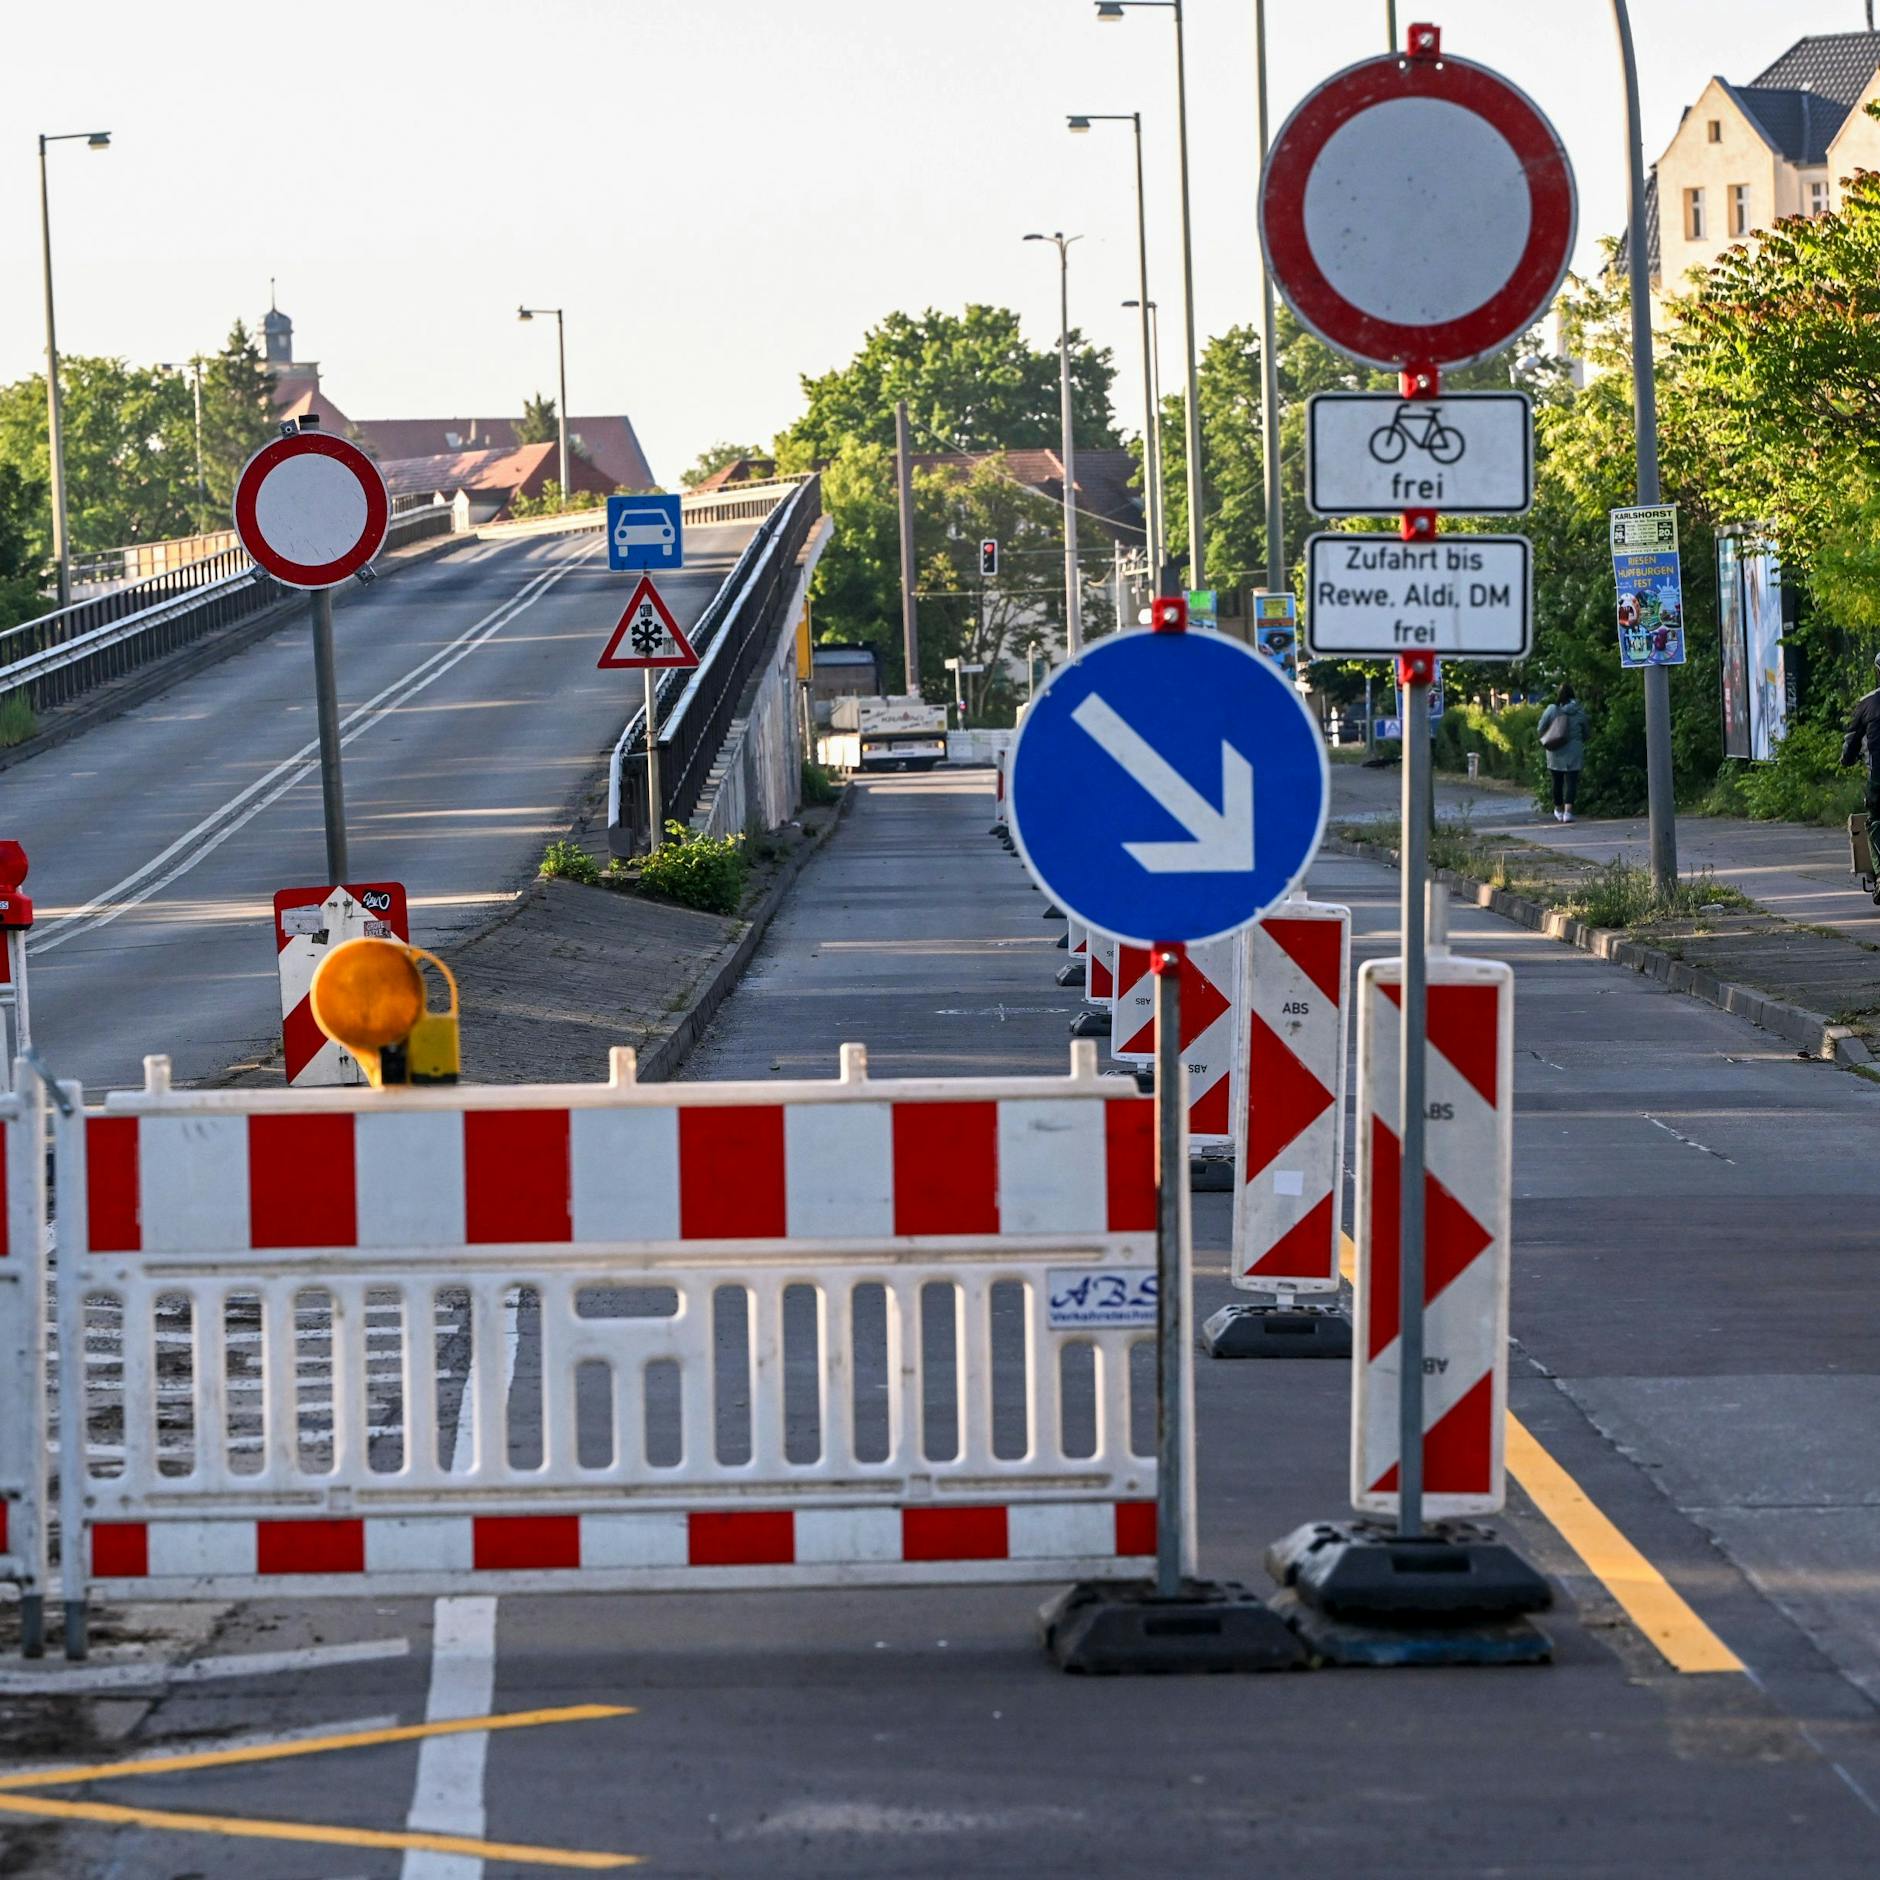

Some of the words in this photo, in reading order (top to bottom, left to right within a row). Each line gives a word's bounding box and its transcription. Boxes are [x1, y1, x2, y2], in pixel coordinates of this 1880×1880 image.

[1392, 472, 1443, 500] frei
[1614, 510, 1673, 520] KARLSHORST
[1345, 546, 1437, 571] Zufahrt
[1447, 546, 1483, 571] bis
[1628, 556, 1656, 566] RIESEN
[1633, 578, 1652, 588] FEST
[1404, 583, 1460, 609] Aldi,
[1470, 583, 1510, 608] DM
[1394, 620, 1436, 643] frei
[1135, 997, 1151, 1005] ABS
[1282, 1002, 1309, 1015] ABS
[1188, 1064, 1208, 1073] ABS
[1424, 1102, 1454, 1121] BS
[1422, 1357, 1449, 1374] AB
